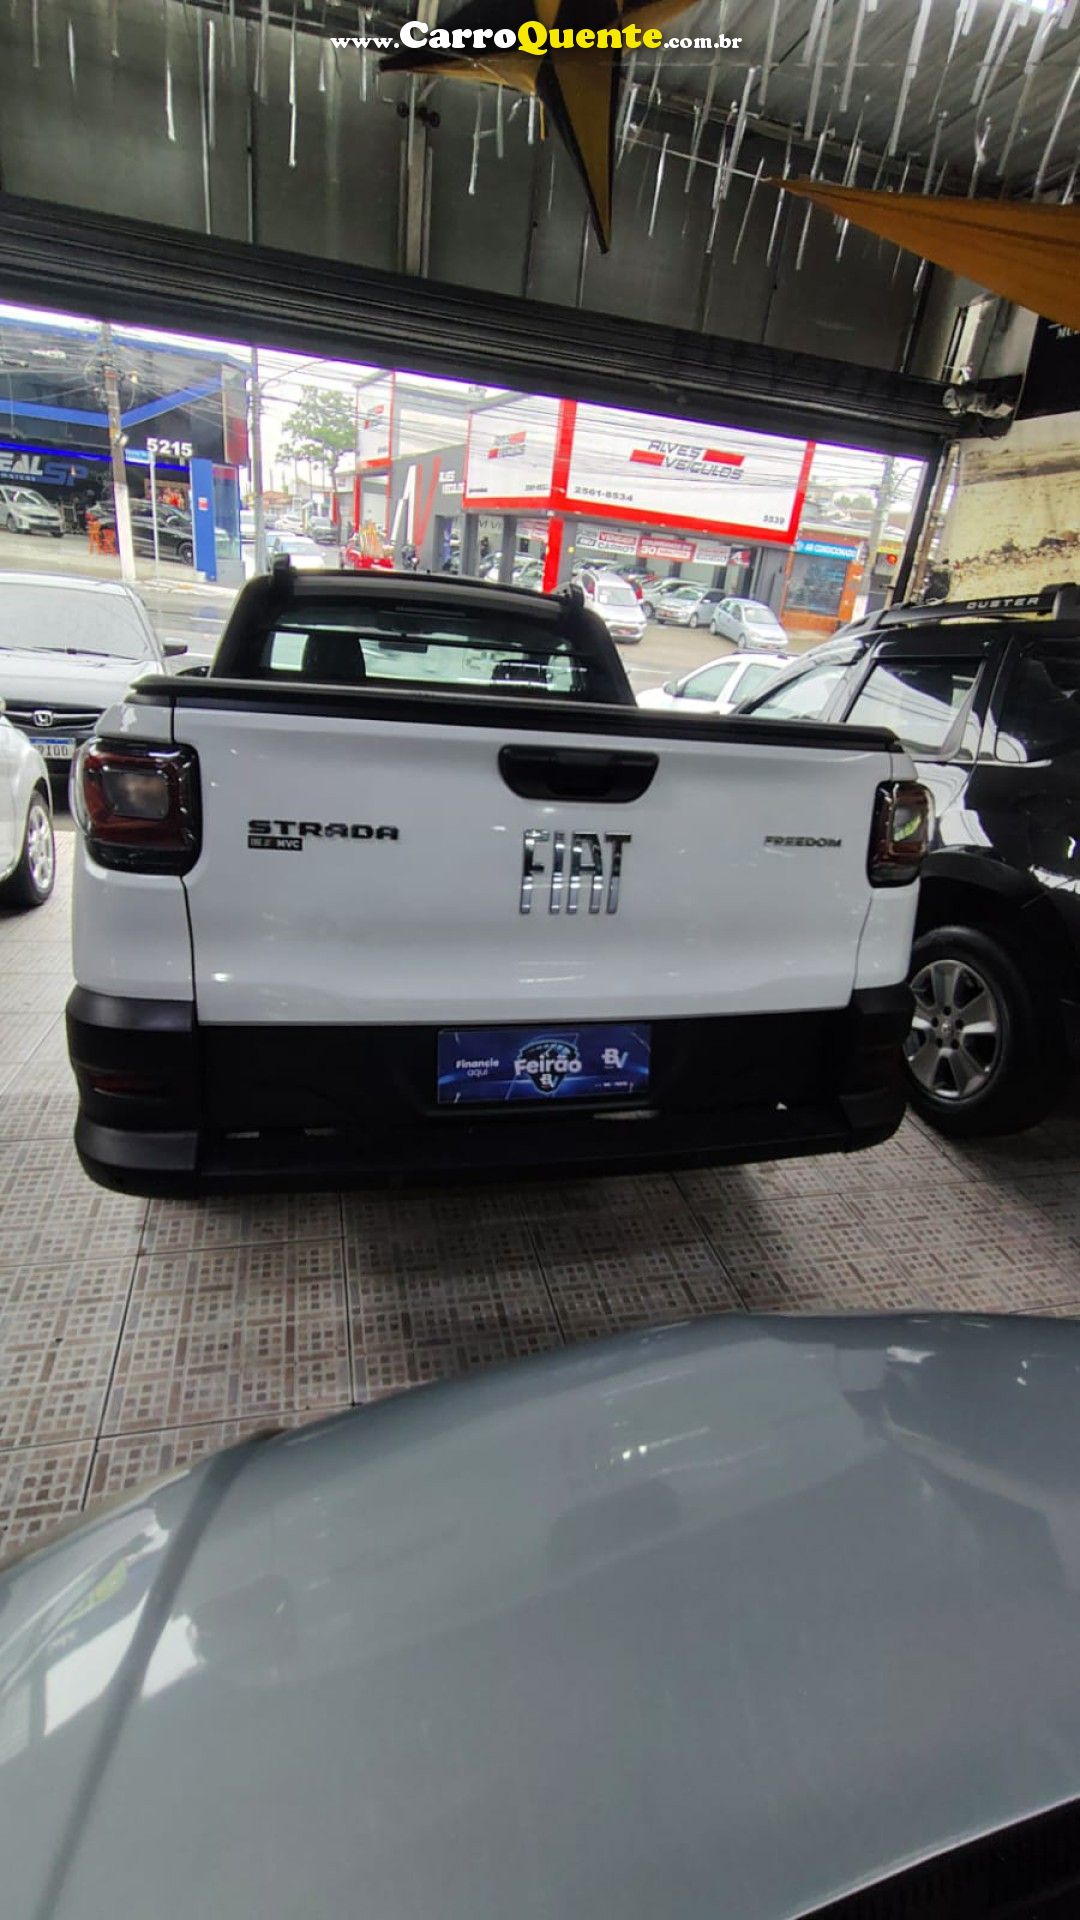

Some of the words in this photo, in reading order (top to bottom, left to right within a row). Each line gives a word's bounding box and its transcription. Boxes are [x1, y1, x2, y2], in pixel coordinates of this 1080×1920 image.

[146, 437, 193, 457] 5215
[647, 439, 701, 459] ALVES
[575, 486, 634, 502] 2561-8534
[966, 597, 1039, 610] DUSTER
[248, 819, 400, 841] STRADA
[764, 835, 842, 848] FREEDOM
[519, 828, 632, 914] FIAT
[514, 1054, 582, 1076] Feirão
[602, 1048, 628, 1068] BV
[466, 1068, 489, 1078] aqui
